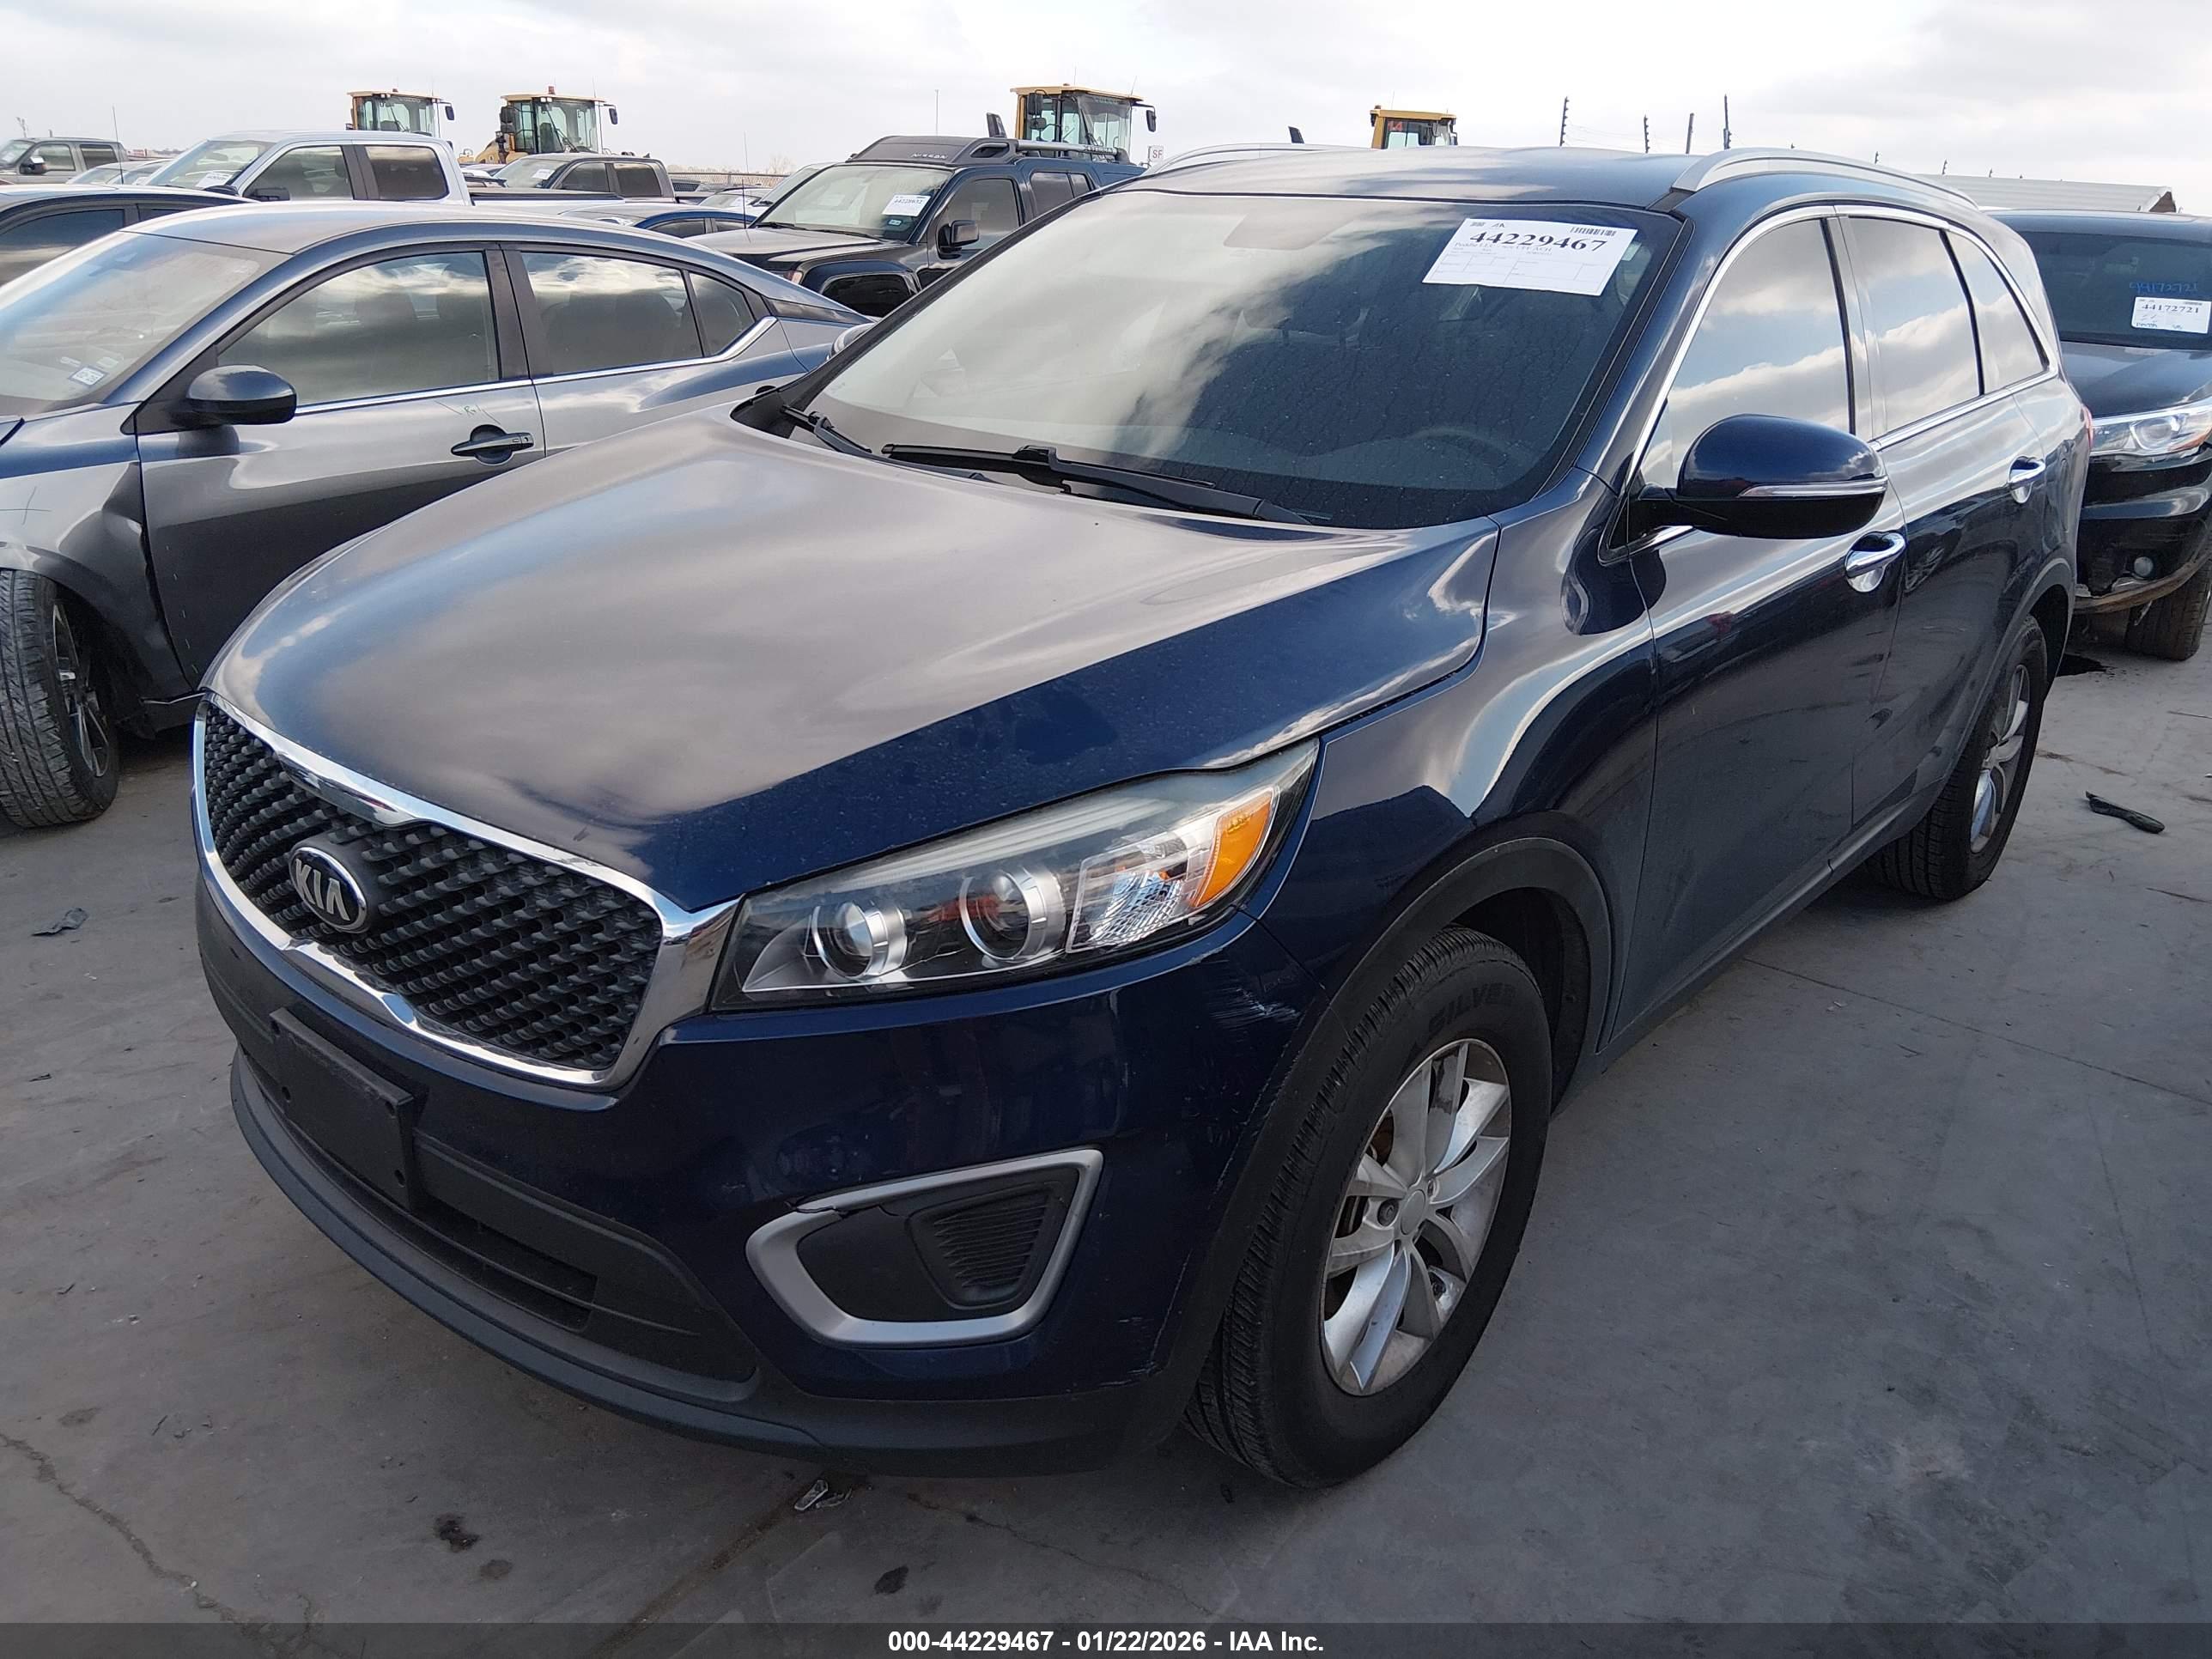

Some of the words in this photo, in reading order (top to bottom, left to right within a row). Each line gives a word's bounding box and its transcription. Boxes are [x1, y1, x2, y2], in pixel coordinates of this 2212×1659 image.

[1469, 231, 1608, 252] 44229467
[2142, 304, 2199, 313] 44172721
[295, 858, 351, 921] KIA
